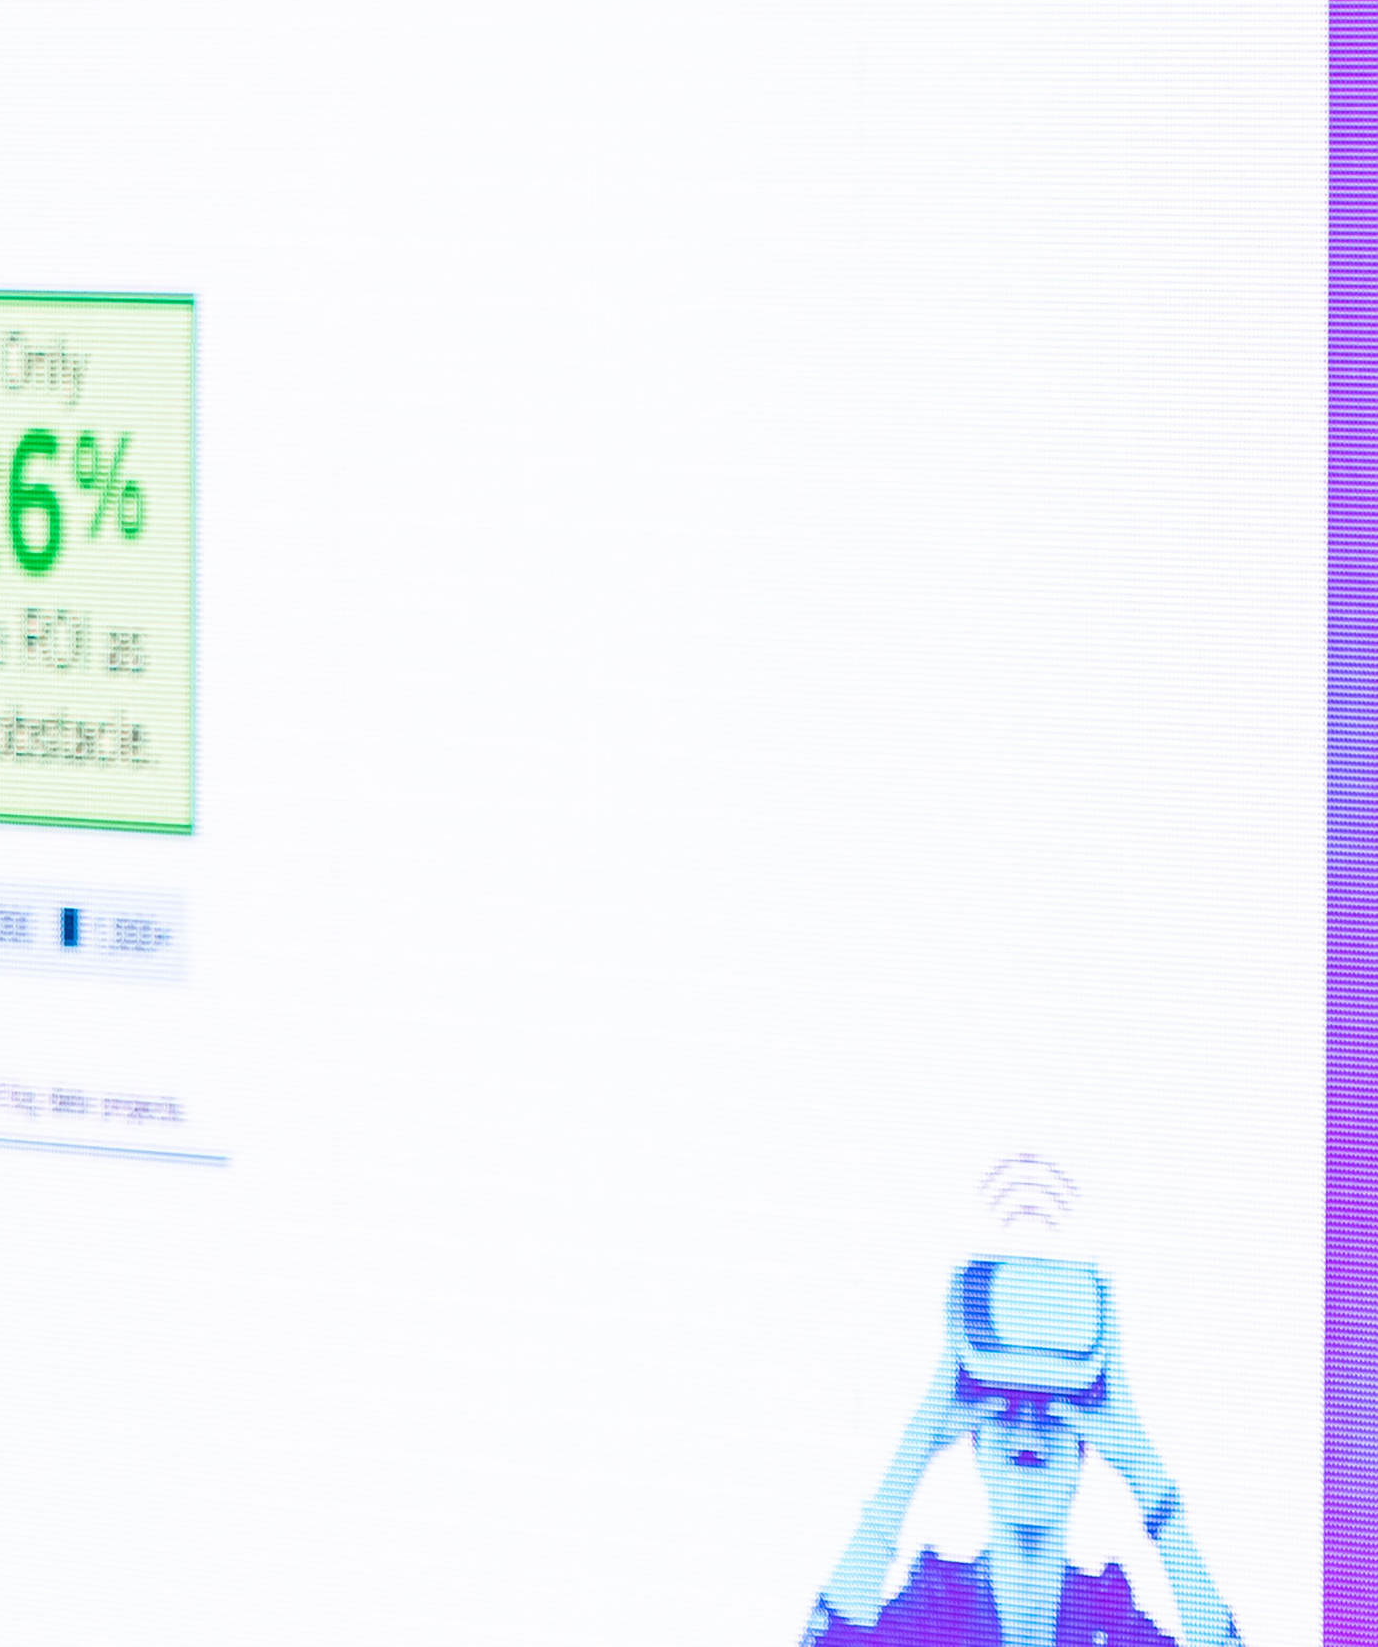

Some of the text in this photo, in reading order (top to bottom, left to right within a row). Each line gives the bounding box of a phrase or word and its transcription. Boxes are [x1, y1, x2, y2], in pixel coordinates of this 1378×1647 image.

[0, 329, 90, 407] Only
[21, 607, 90, 672] ROI
[105, 628, 147, 675] as
